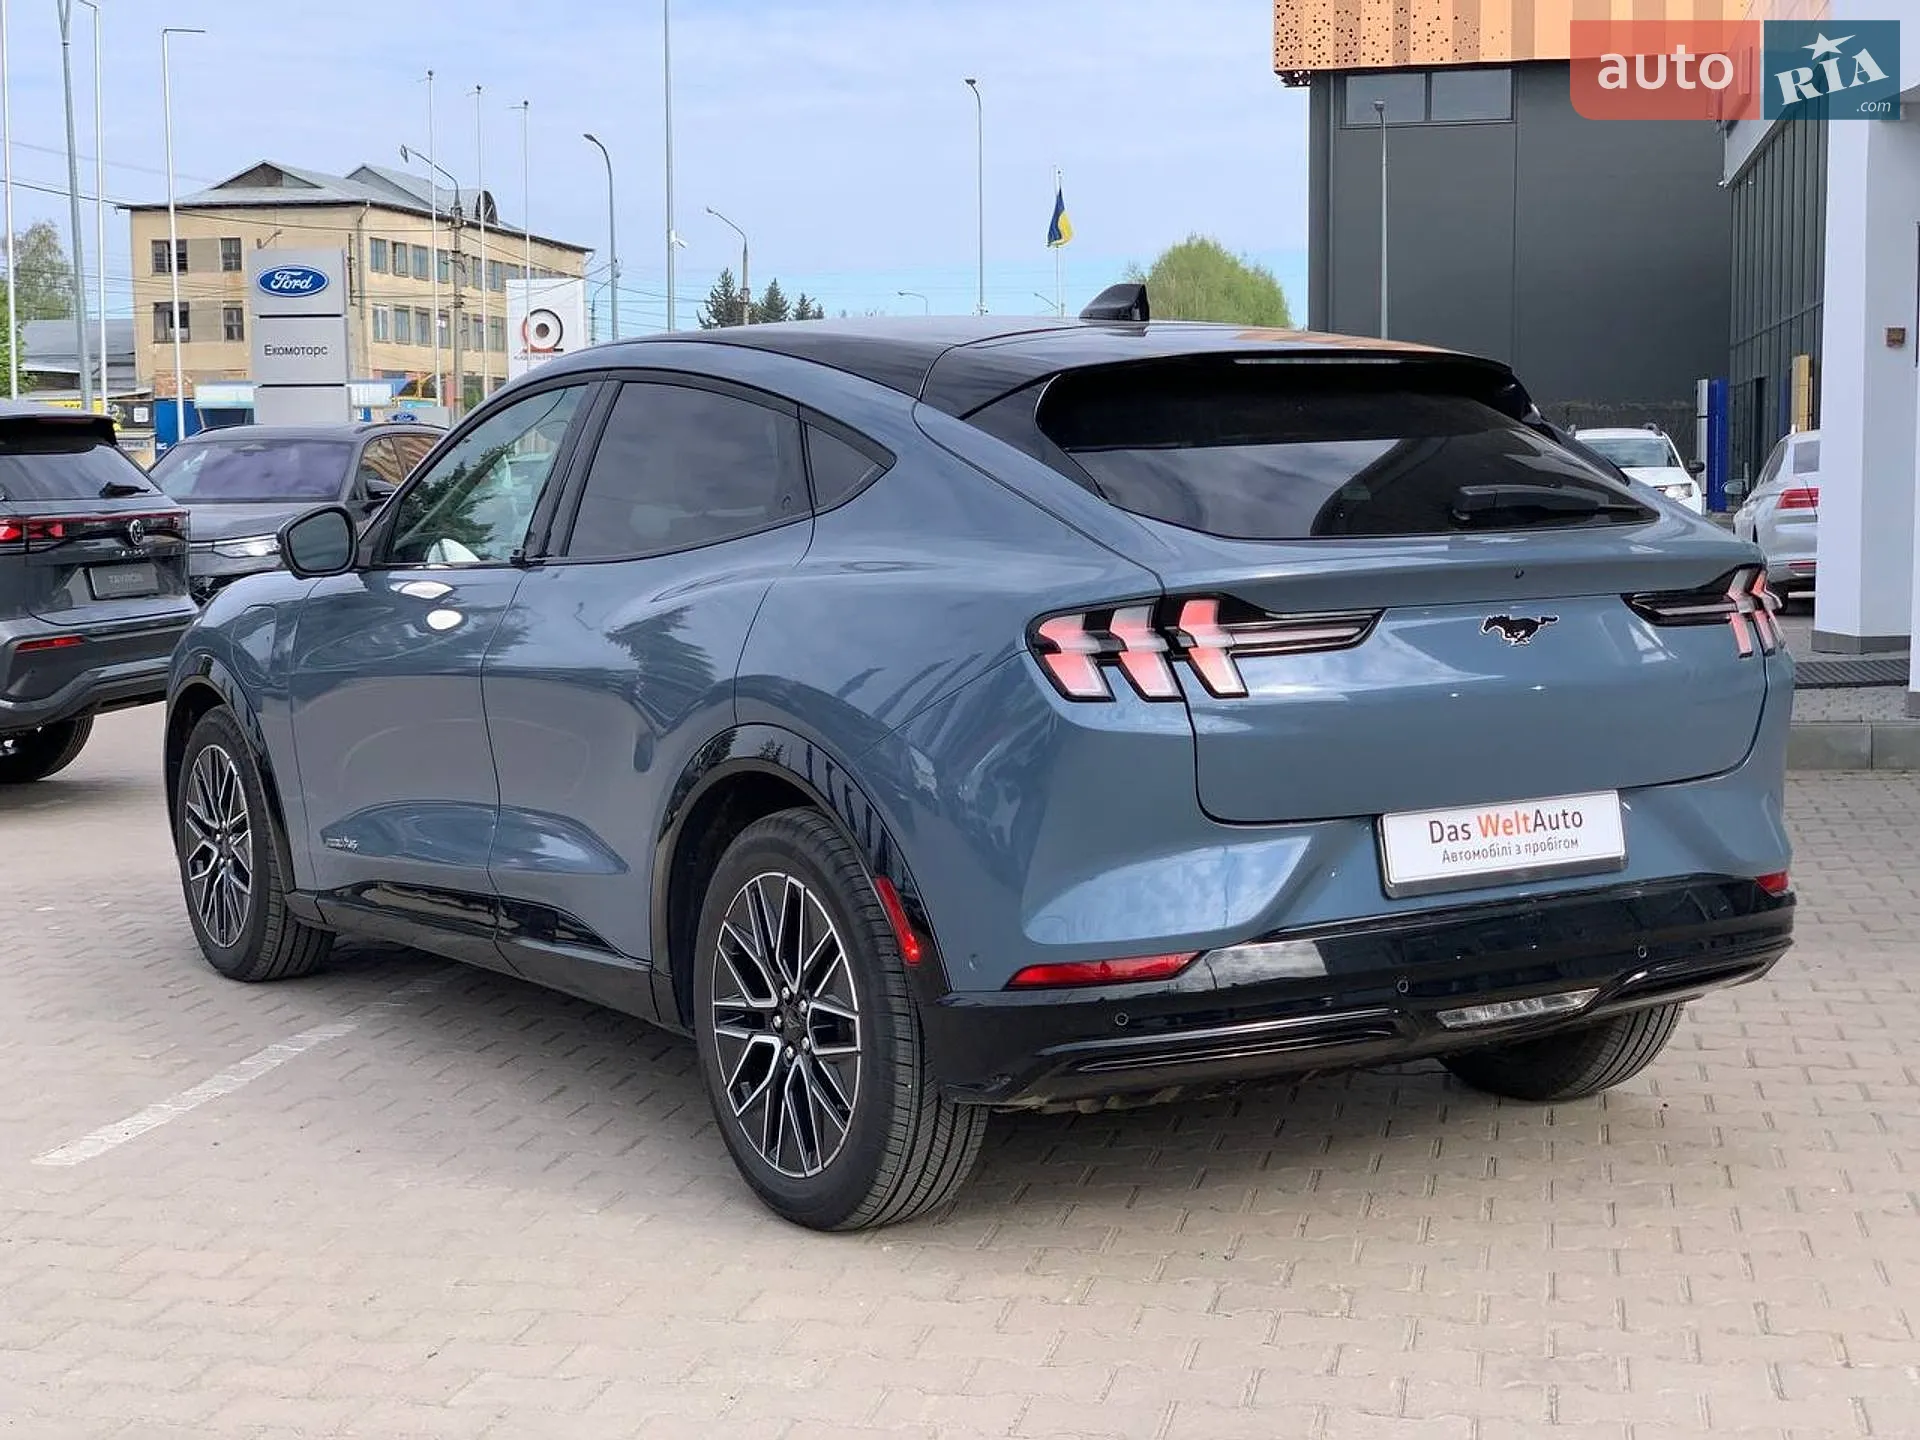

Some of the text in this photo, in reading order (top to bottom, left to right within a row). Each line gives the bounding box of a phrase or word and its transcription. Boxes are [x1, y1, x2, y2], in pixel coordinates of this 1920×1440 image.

[270, 271, 313, 289] Ford
[263, 344, 328, 357] Екомоторс
[1428, 808, 1584, 844] Das WeltAuto
[1441, 836, 1579, 864] Автомобілі з пробігом
